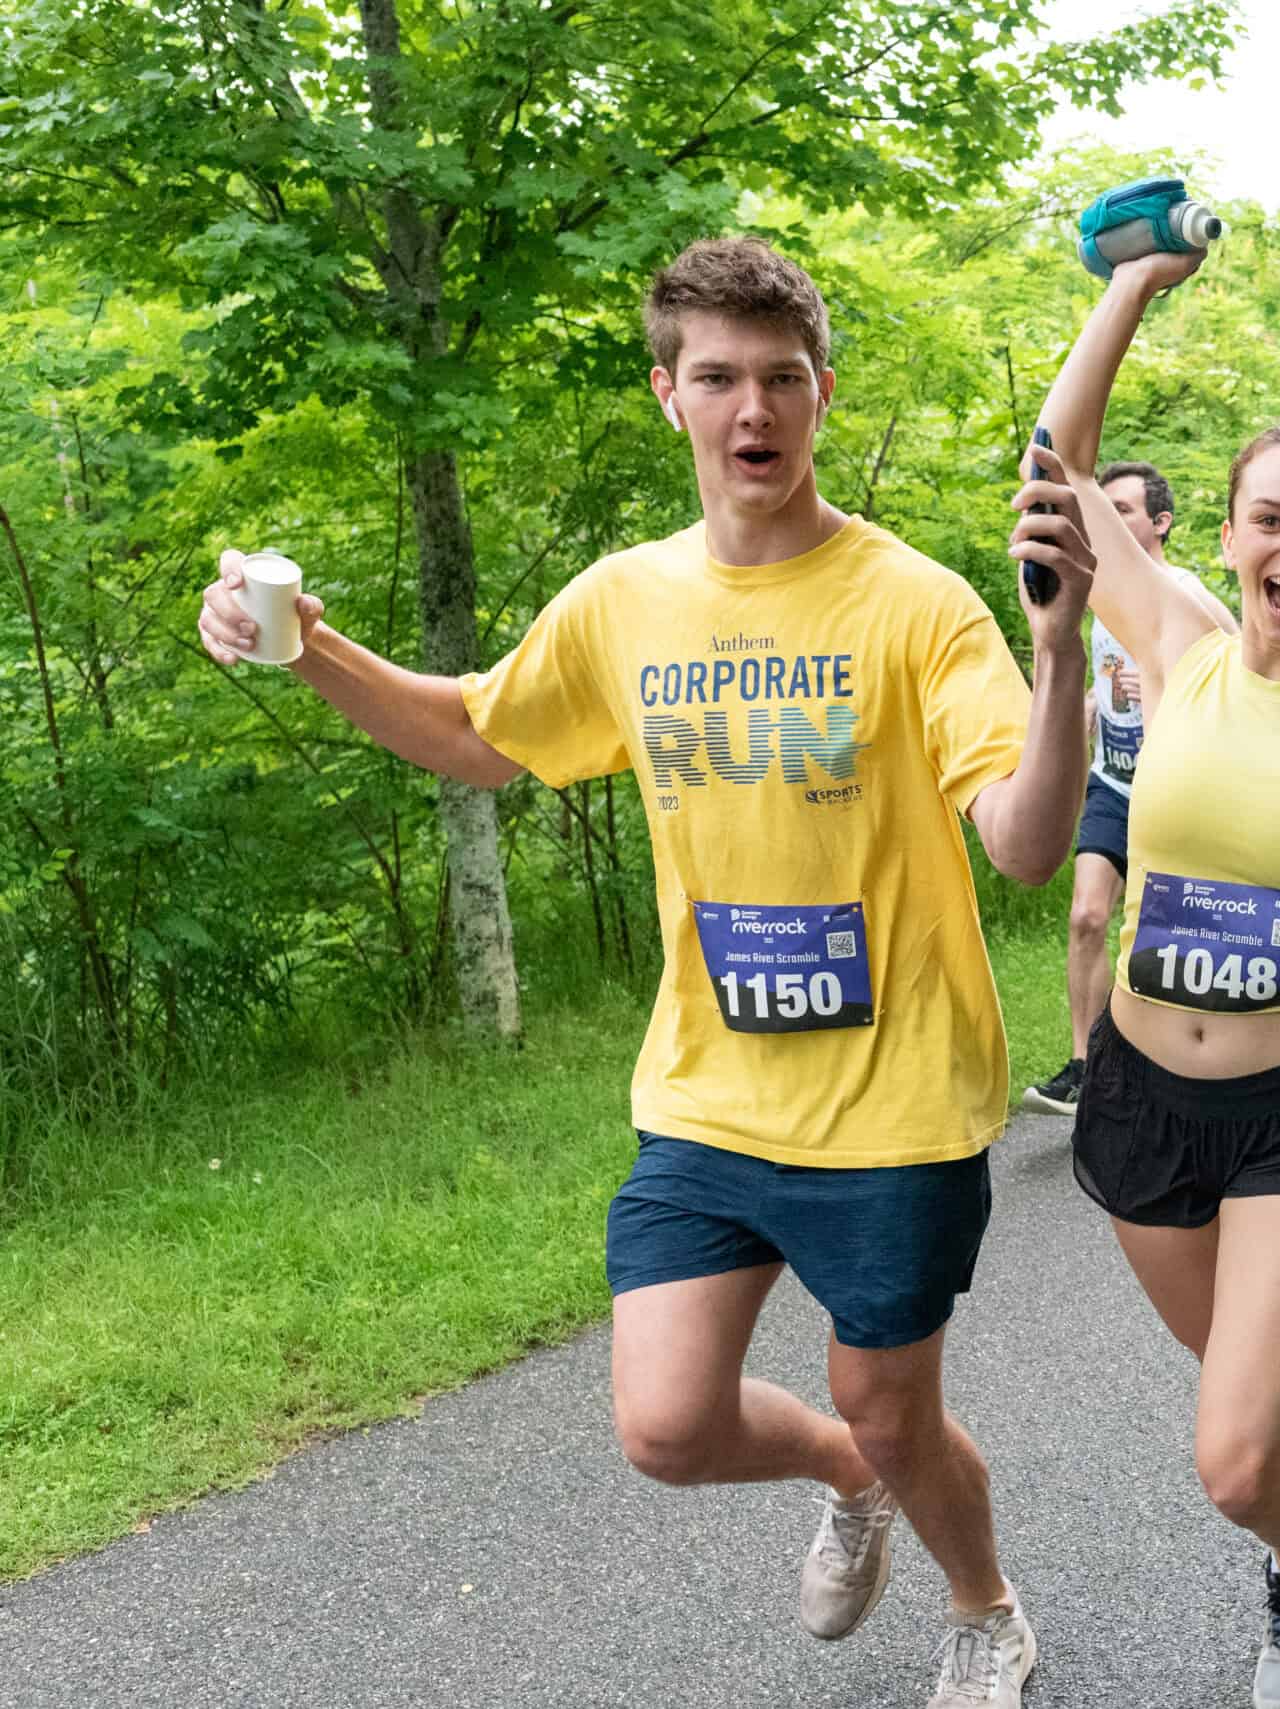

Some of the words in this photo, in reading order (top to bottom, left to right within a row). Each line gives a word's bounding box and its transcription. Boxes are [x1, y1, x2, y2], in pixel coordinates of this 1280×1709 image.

[709, 632, 775, 652] Anthem
[640, 655, 854, 707] CORPORATE
[643, 705, 870, 788] RUN
[819, 784, 862, 800] SPORTS
[1182, 895, 1259, 916] riverrock
[731, 918, 808, 935] riverrock
[1171, 924, 1198, 937] James
[1200, 927, 1220, 941] River
[1222, 930, 1264, 947] Scramble
[725, 951, 751, 962] James
[752, 952, 775, 963] River
[776, 951, 821, 964] Scramble
[1157, 943, 1278, 1001] 1048
[720, 971, 843, 1018] 1150
